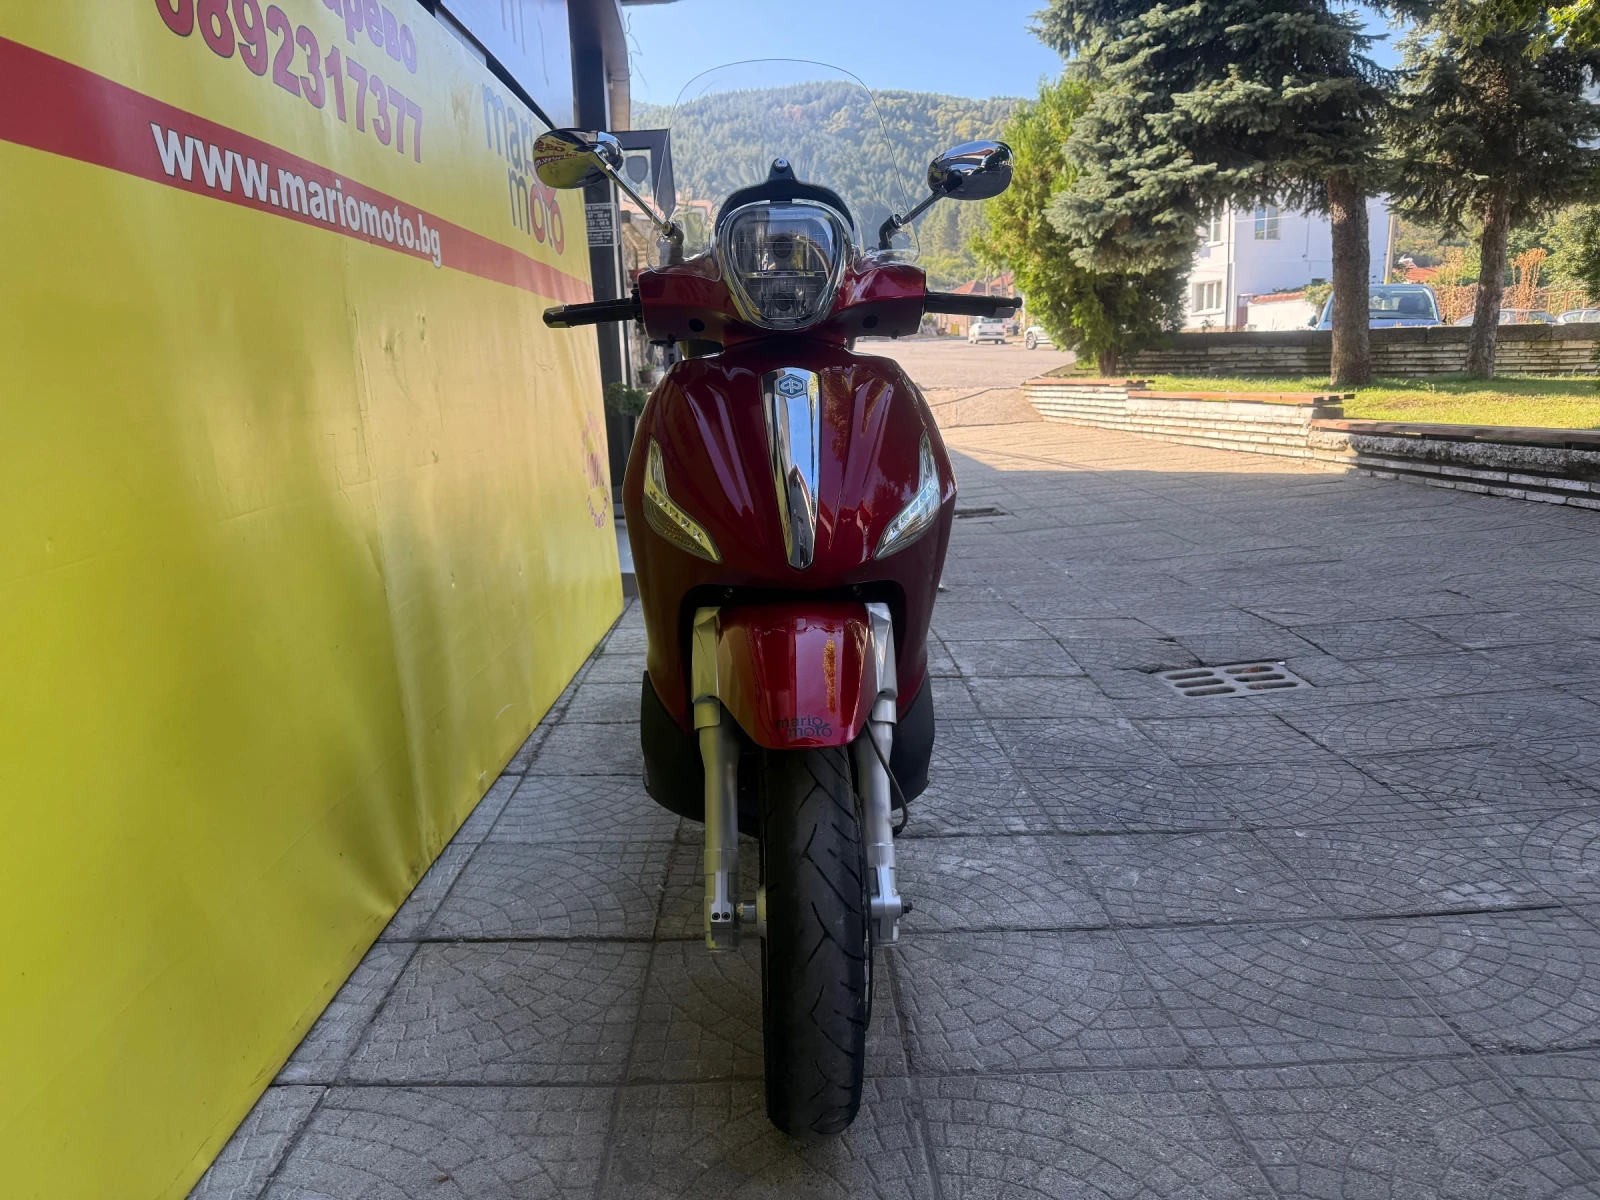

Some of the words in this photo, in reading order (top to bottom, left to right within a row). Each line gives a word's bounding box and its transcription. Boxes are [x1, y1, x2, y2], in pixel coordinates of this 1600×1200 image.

[482, 83, 534, 176] mari
[149, 121, 442, 268] www.mariomoto.bg
[508, 168, 565, 255] moto
[776, 715, 823, 729] mario
[788, 724, 833, 738] moto
